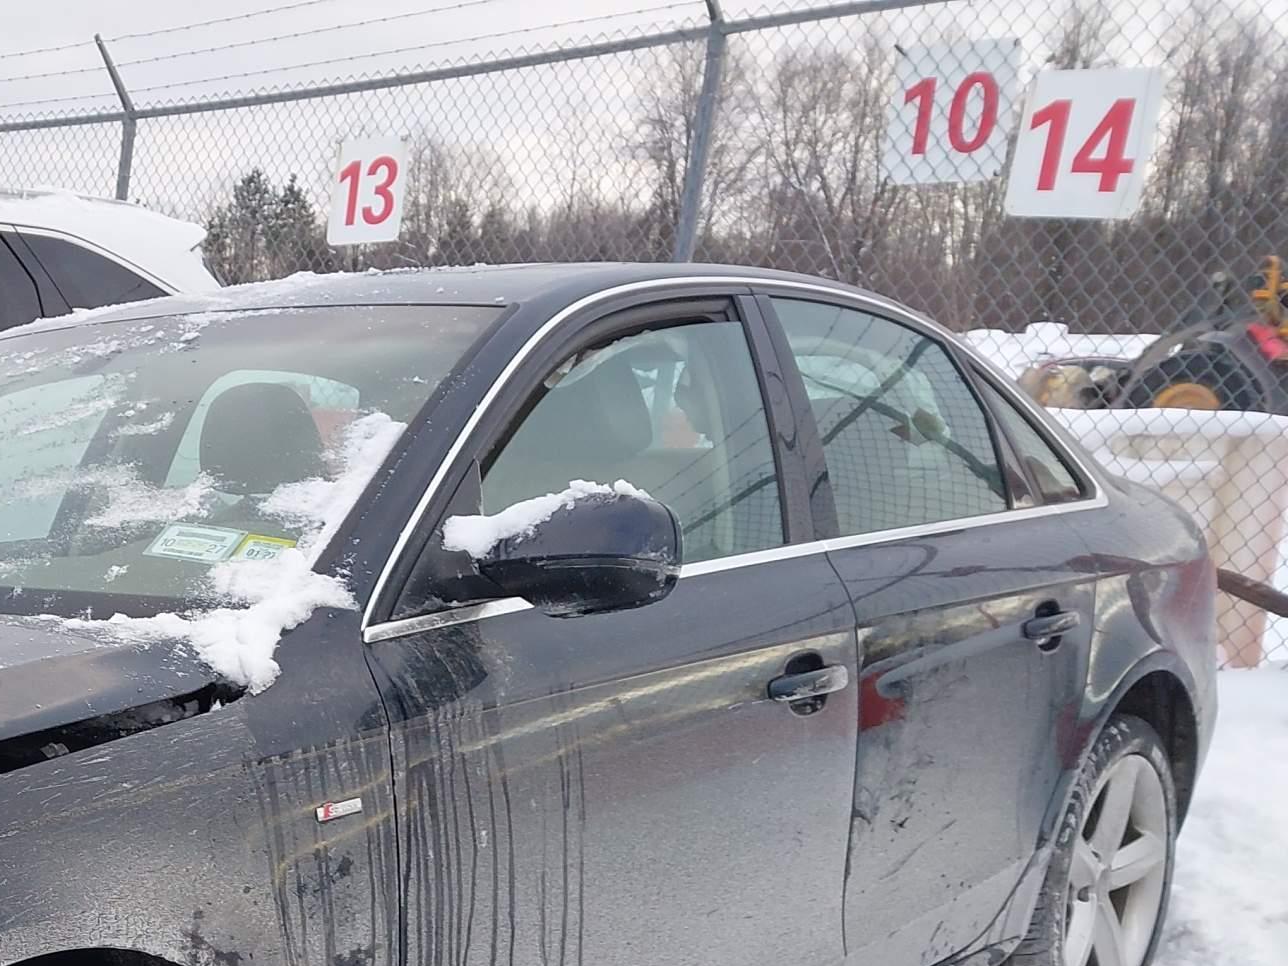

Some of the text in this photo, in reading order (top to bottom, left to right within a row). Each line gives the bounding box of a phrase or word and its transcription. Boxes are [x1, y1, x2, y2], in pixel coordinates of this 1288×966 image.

[904, 71, 999, 154] 10
[1030, 97, 1137, 192] 14
[339, 155, 398, 226] 13
